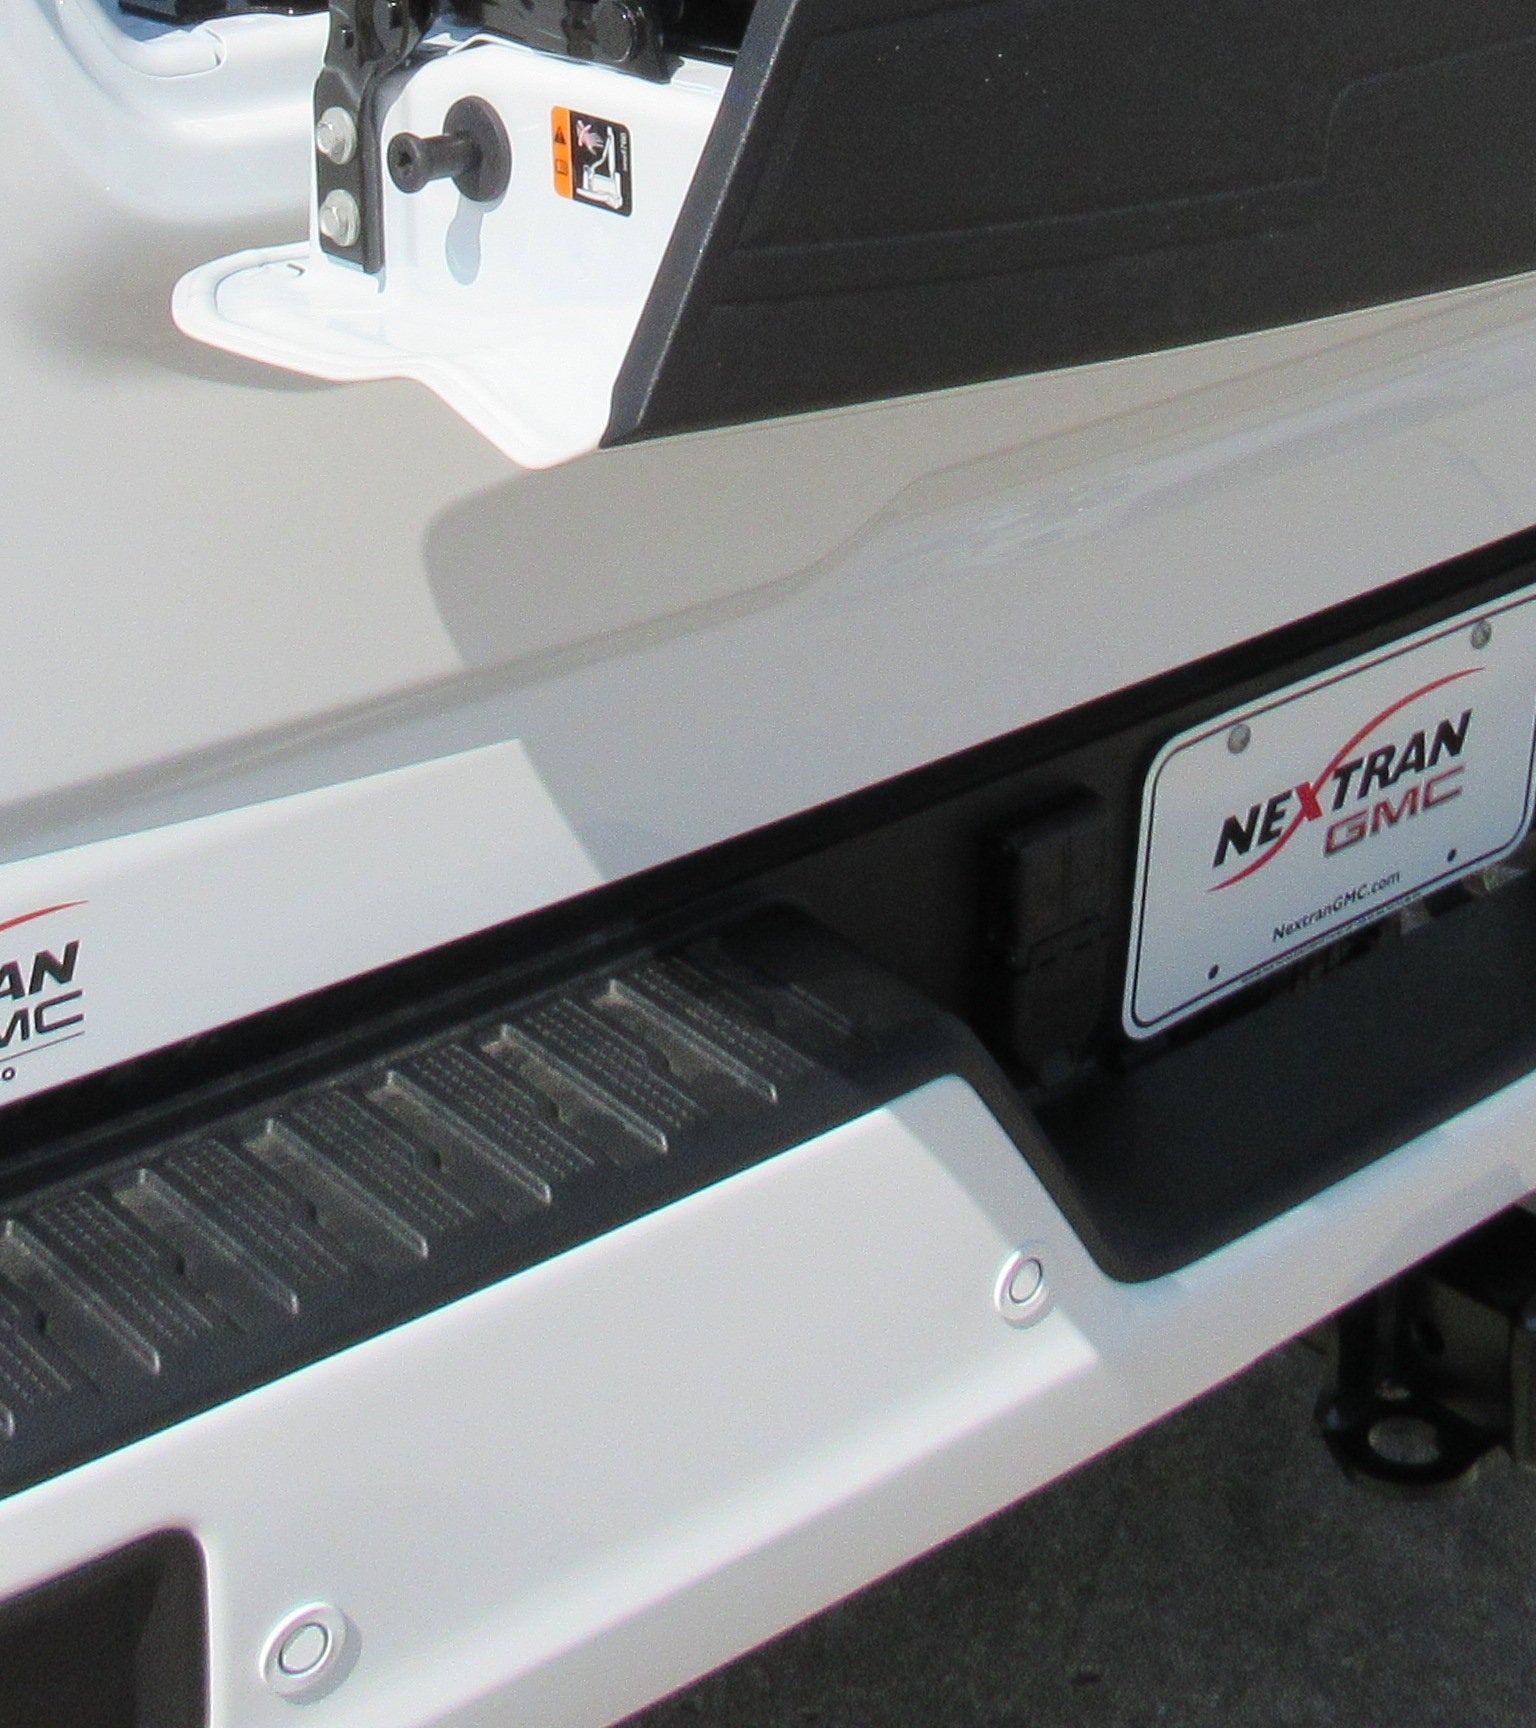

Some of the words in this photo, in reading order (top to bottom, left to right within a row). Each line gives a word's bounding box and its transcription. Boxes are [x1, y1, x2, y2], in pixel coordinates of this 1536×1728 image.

[1211, 707, 1474, 870] NEXTRAN
[1322, 765, 1465, 859] GMC
[1272, 872, 1401, 943] NextranGMC.com
